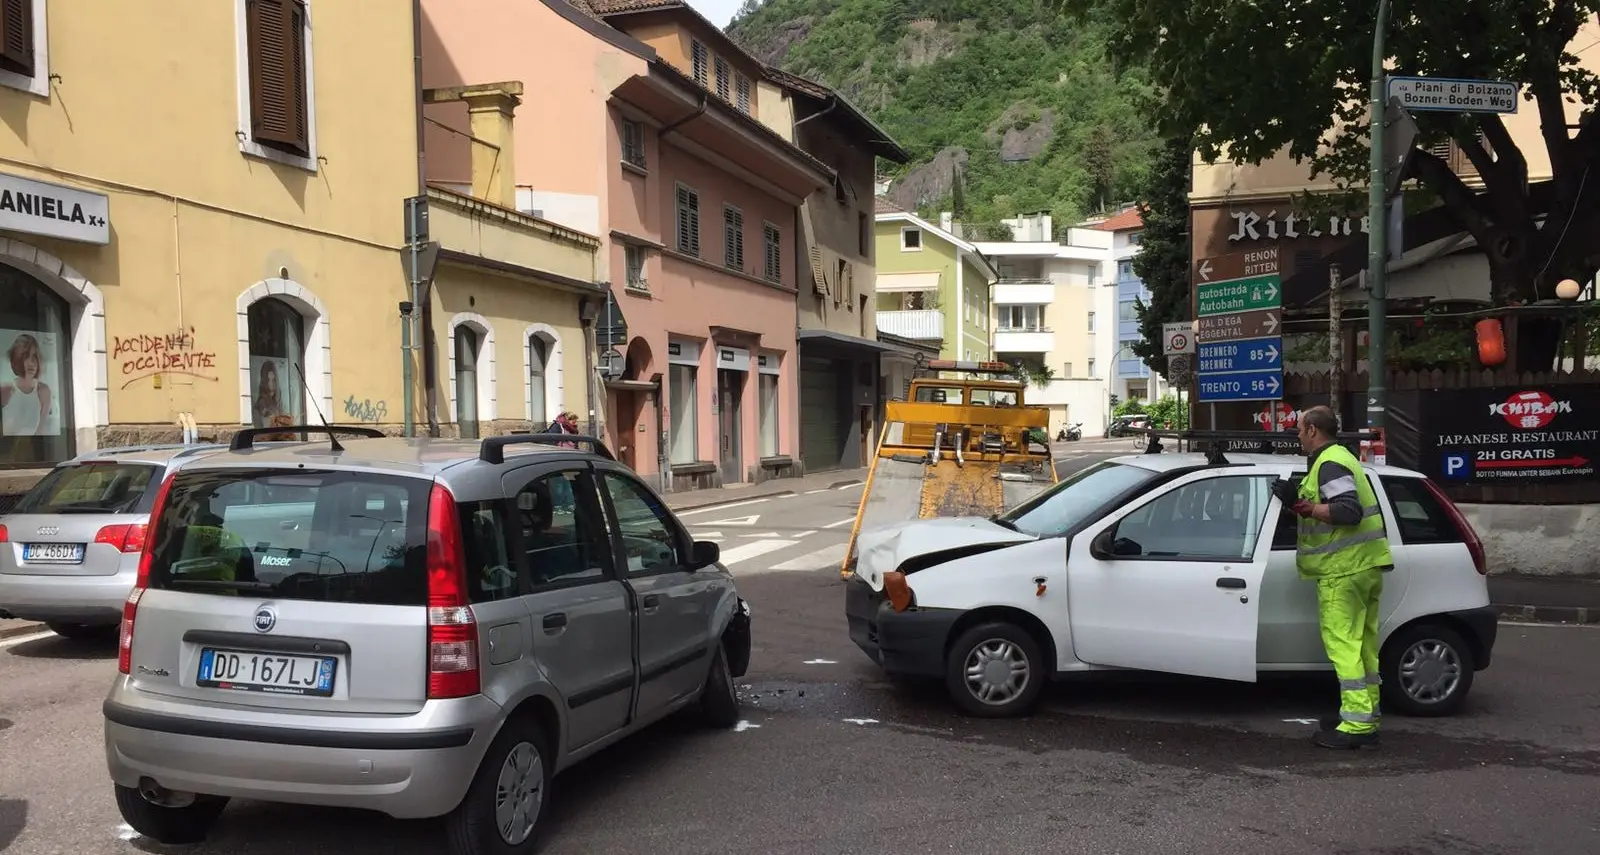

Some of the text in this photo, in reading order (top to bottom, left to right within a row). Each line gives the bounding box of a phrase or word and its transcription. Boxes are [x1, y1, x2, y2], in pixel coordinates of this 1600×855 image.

[1415, 82, 1443, 93] Piani
[1450, 83, 1461, 93] di
[1467, 85, 1513, 96] Bolzano
[1244, 249, 1278, 263] RENON
[1245, 262, 1278, 275] RITTEN
[1200, 284, 1247, 299] autostrada
[1200, 299, 1244, 312] Autobahn
[1200, 319, 1215, 328] VAL
[1200, 327, 1243, 338] EGGENTAL
[1200, 345, 1264, 360] BRENNERO 85
[1200, 358, 1233, 370] BRENNER
[1201, 381, 1265, 392] TRENTO 56
[1488, 401, 1572, 416] ICHIBAN
[1437, 430, 1599, 446] JAPANESE RESTAURANT
[1477, 449, 1556, 460] 2H GRATIS
[1562, 467, 1594, 475] Eurospin
[255, 615, 271, 625] FIAT
[213, 654, 240, 679] DD
[250, 656, 318, 686] 167LJ
